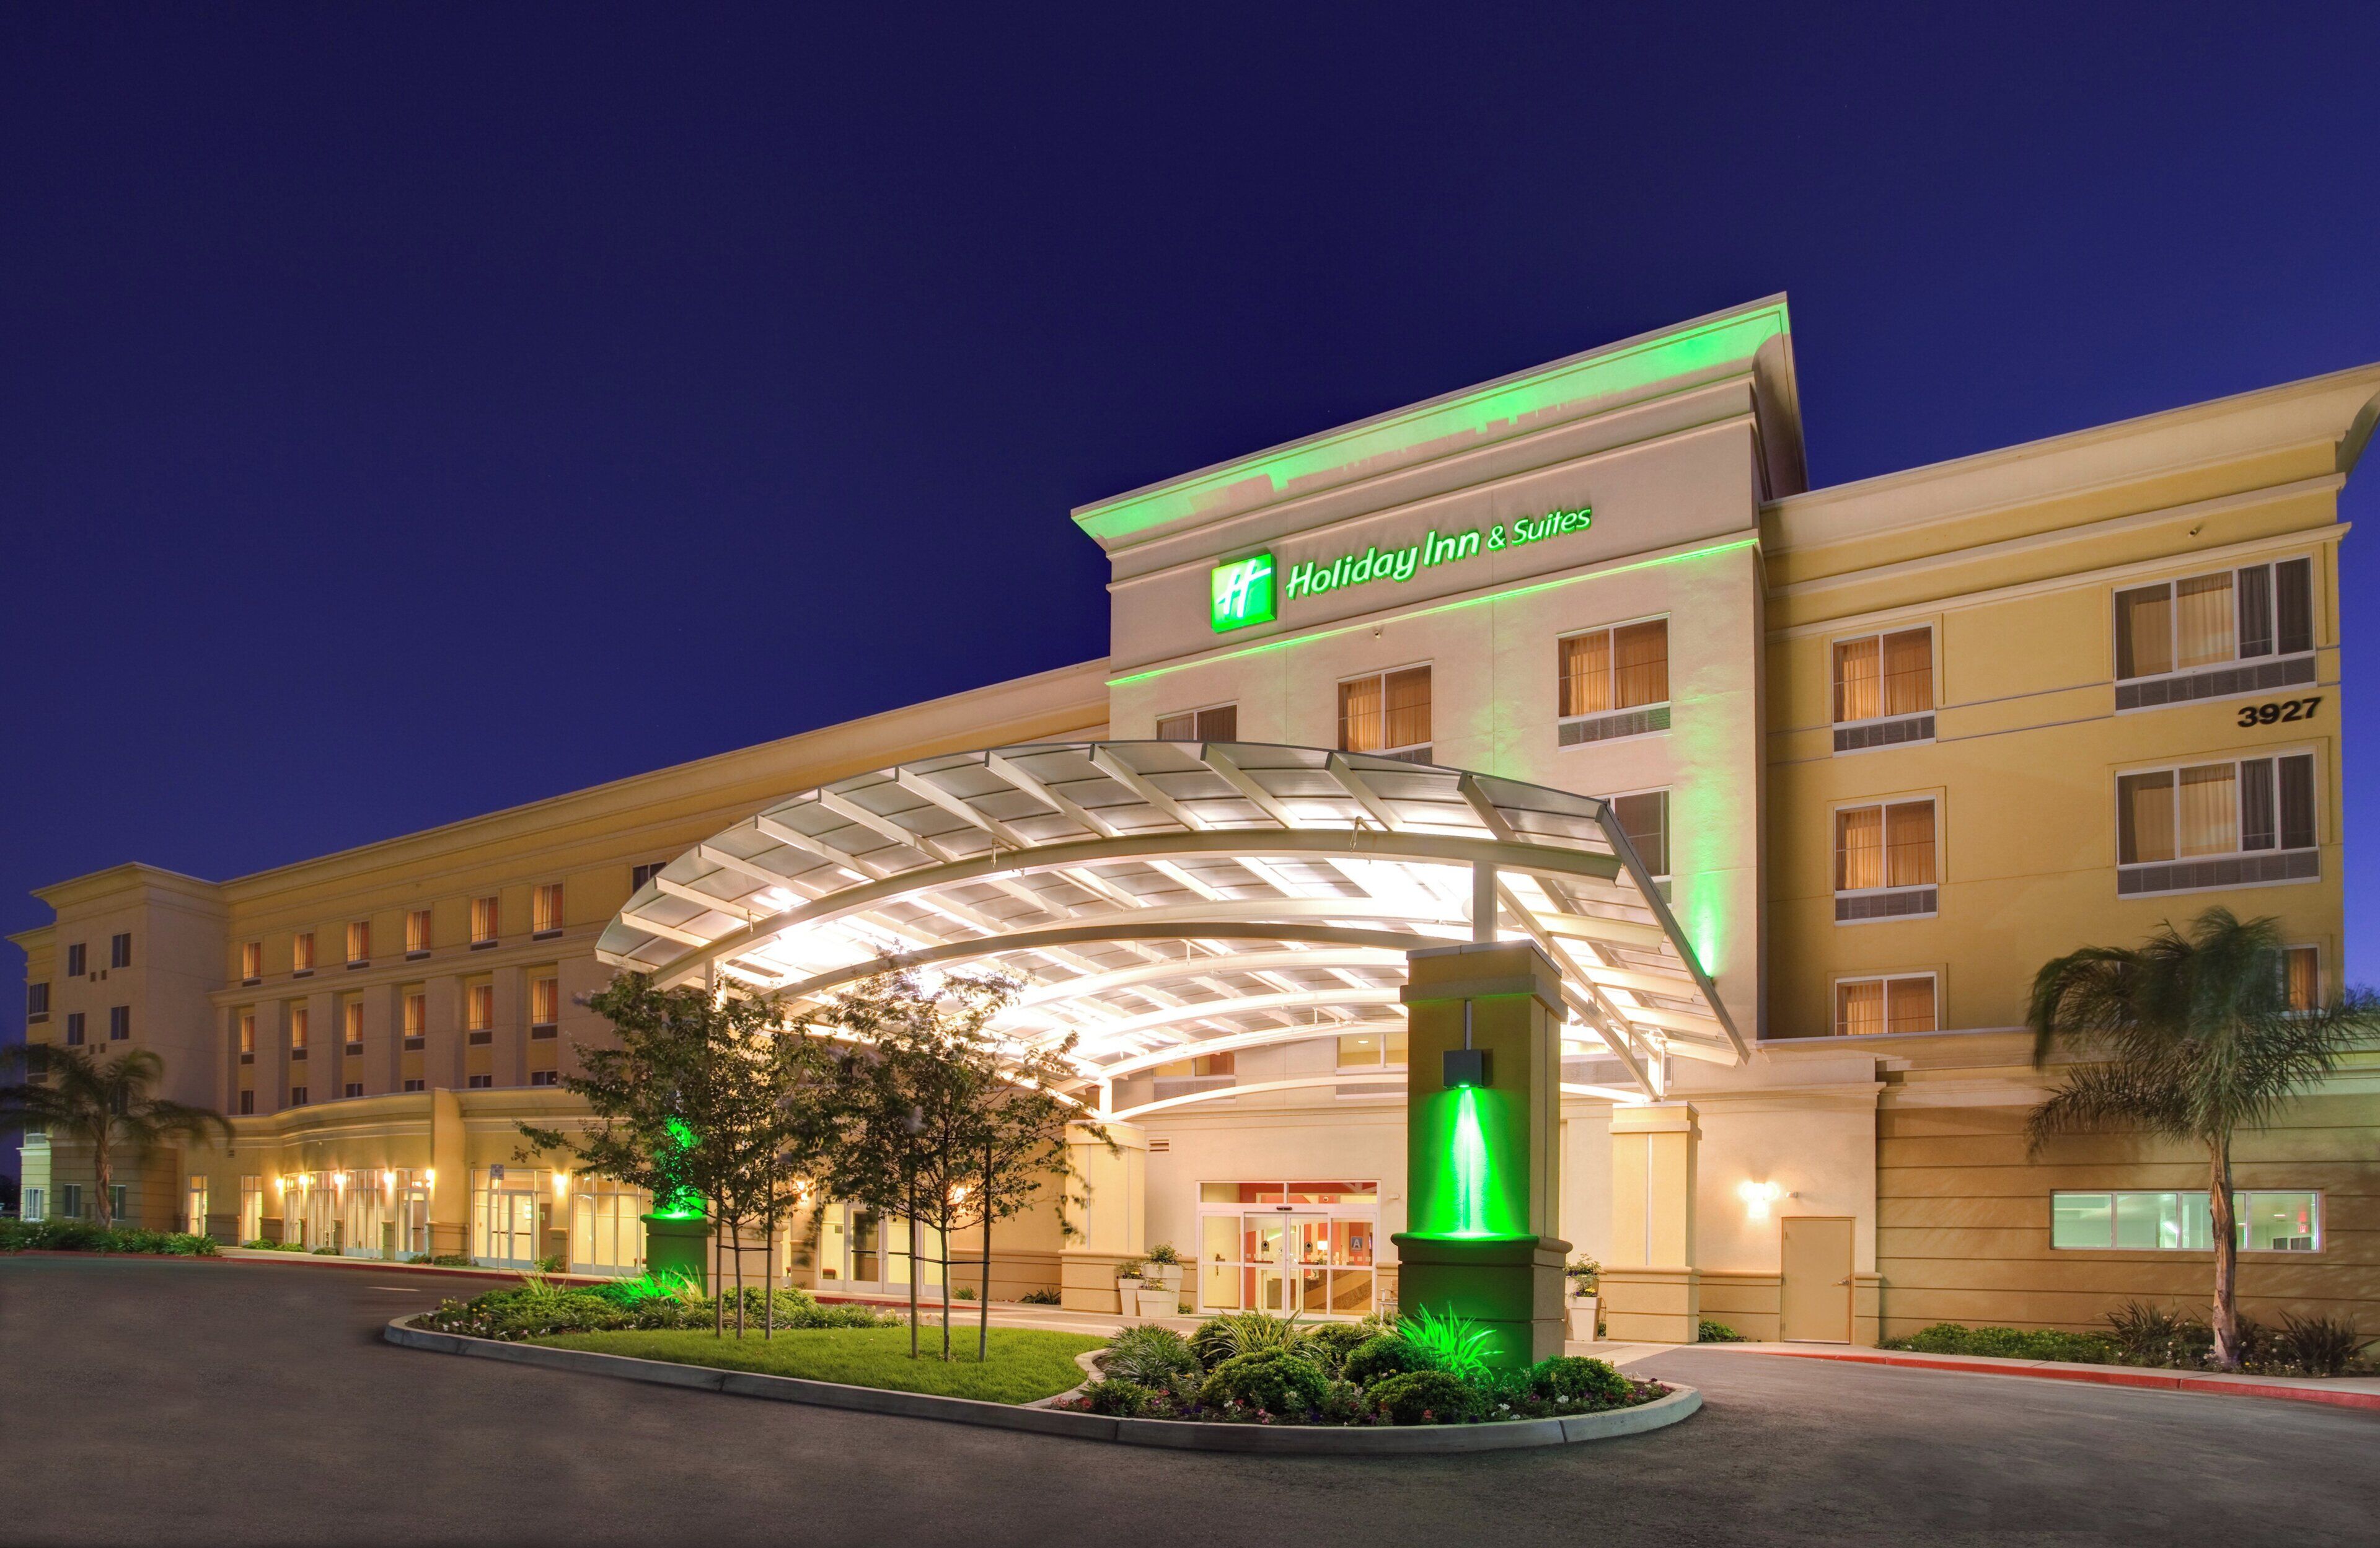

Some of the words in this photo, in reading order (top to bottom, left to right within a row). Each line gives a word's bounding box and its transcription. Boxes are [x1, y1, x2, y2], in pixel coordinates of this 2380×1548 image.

[1285, 546, 1419, 599] Holiday
[1422, 530, 1481, 566] Inn
[1487, 526, 1506, 550] &
[1511, 508, 1592, 546] Suites
[2237, 697, 2322, 728] 3927
[1353, 1239, 1361, 1248] A
